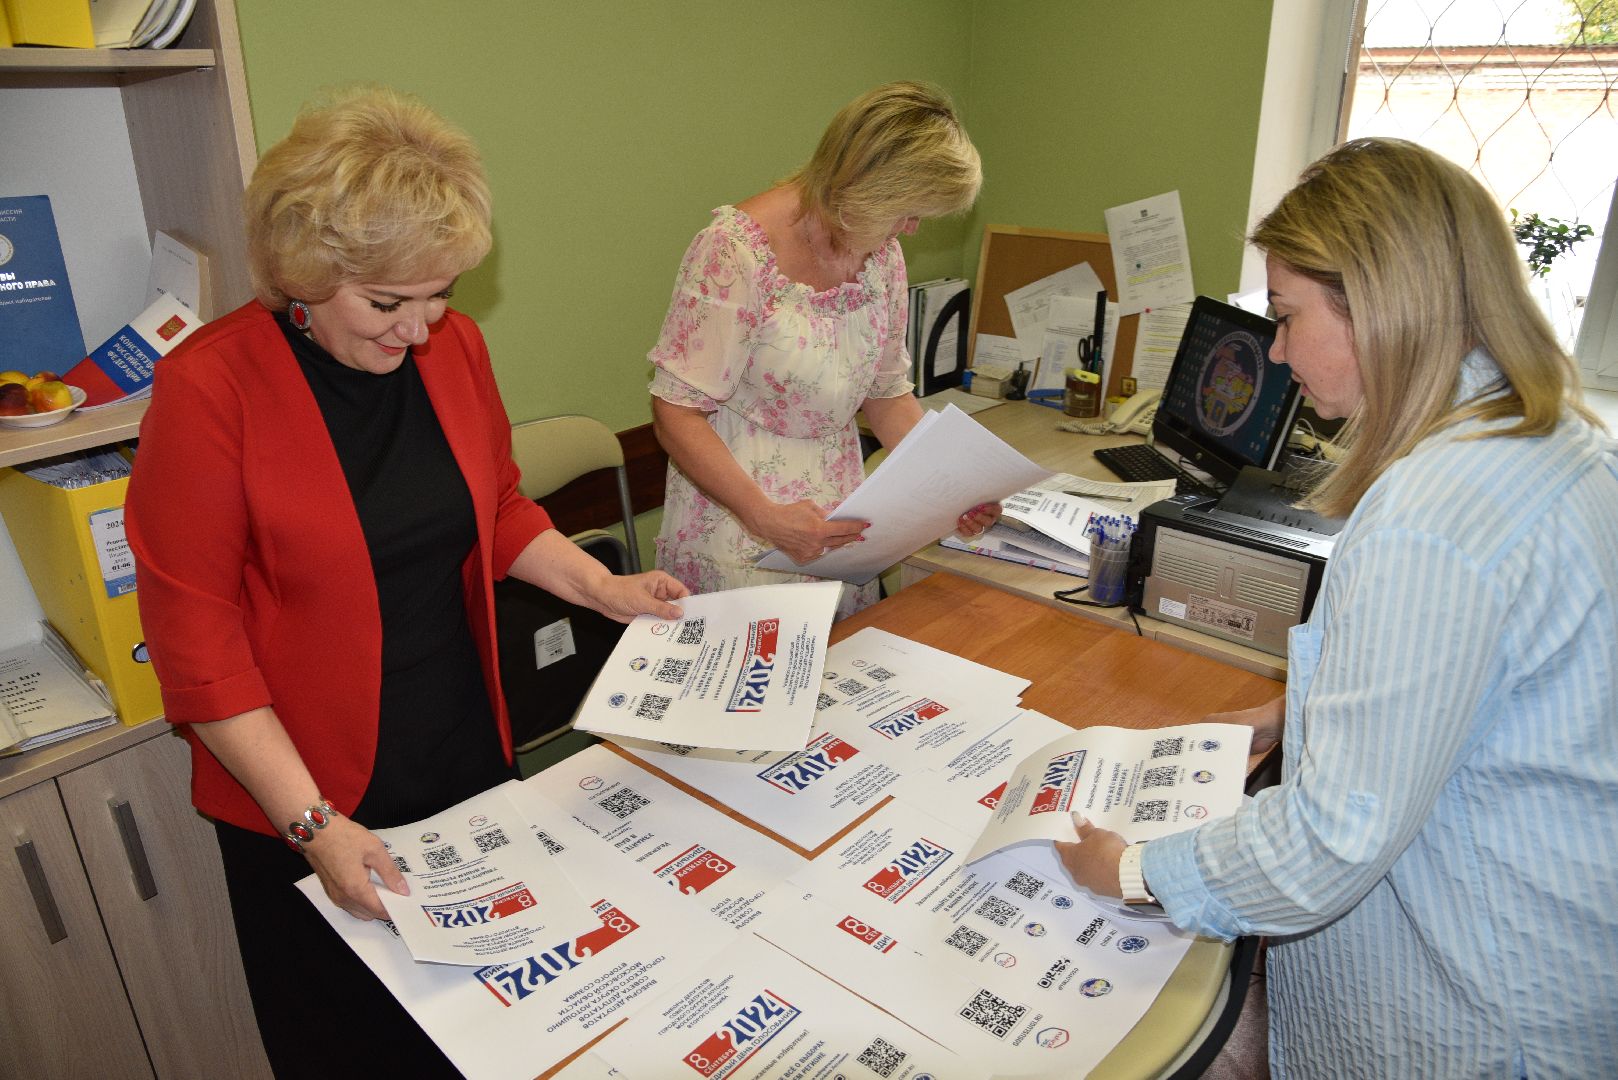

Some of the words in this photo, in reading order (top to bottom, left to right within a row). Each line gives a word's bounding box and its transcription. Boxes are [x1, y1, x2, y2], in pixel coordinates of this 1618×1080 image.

[25, 279, 57, 289] ПРАВА
[106, 349, 141, 383] ФЕДЕРАЦИИ
[113, 341, 152, 378] РОССИЙСКОЙ
[762, 621, 778, 634] 8
[738, 654, 777, 707] 2024
[772, 747, 845, 792] 2024
[1030, 801, 1050, 814] 8
[672, 845, 705, 868] ЕДИНЫЙ
[675, 853, 712, 877] СЕНТЯБРЯ
[703, 857, 729, 874] 8
[883, 839, 940, 880] 2024
[865, 880, 886, 893] 8
[515, 894, 533, 908] 8
[430, 901, 501, 930] 2024
[606, 915, 631, 934] 8
[728, 907, 753, 925] СОВЕТА
[734, 910, 762, 930] ВЫБОРЫ
[839, 917, 870, 940] 8
[490, 933, 596, 1002] 2024
[591, 960, 642, 995] МОСКОВСКОЙ
[592, 961, 627, 984] ВТОРОГО
[617, 954, 665, 987] ГОРОДСКОГО
[562, 981, 594, 1004] СОЗЫВА
[590, 983, 620, 1005] ОКРУГА
[619, 974, 649, 995] СОВЕТА
[624, 978, 657, 1001] ВЫБОРЫ
[556, 991, 594, 1016] ОБЛАСТИ
[577, 992, 621, 1022] ДЕПУТАТОВ
[580, 998, 625, 1029] ДЕПУТАТОВ
[545, 1001, 592, 1033] ЛОТОШИНО
[713, 992, 786, 1048] 2024
[735, 1045, 754, 1060] ДЕНЬ
[749, 1008, 795, 1046] ГОЛОСОВАНИЯ
[775, 1028, 811, 1060] избиратели!
[686, 1050, 712, 1070] 8
[702, 1047, 736, 1074] СЕНТЯБРЯ
[782, 1065, 796, 1078] ВСЁ
[798, 1039, 825, 1063] ВЫБОРАХ
[800, 1051, 826, 1074] РЕГИОНЕ
